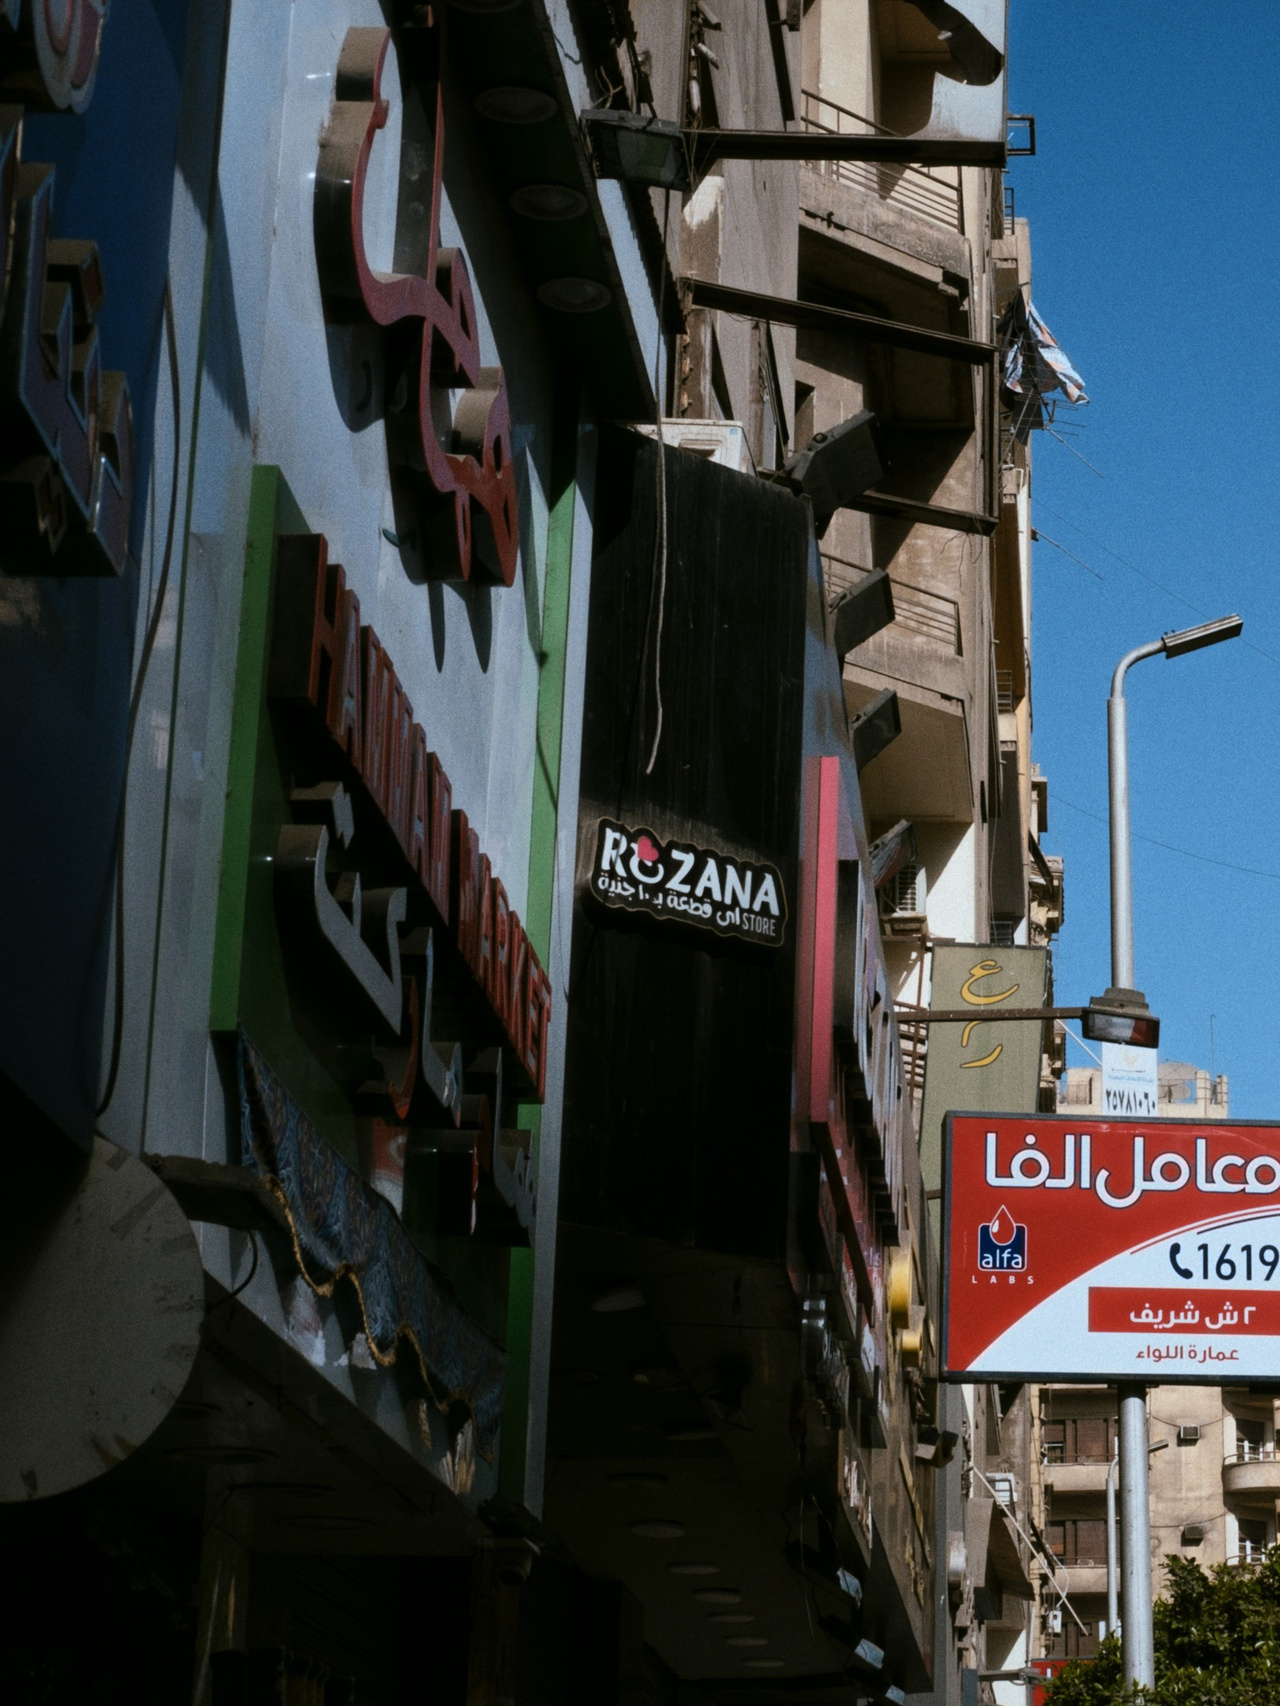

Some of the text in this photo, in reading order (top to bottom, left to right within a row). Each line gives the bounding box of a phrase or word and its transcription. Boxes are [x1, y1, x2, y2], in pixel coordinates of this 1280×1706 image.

[600, 827, 780, 917] ROZANA
[741, 912, 777, 938] STORE
[457, 808, 552, 1104] MARKET
[983, 1130, 1094, 1192] الفا
[980, 1246, 1024, 1270] alfa
[970, 1274, 1035, 1286] LABS
[1128, 1300, 1202, 1331] شريف
[1204, 1300, 1239, 1330] ش
[1135, 1343, 1241, 1364] عمارة اللواء
